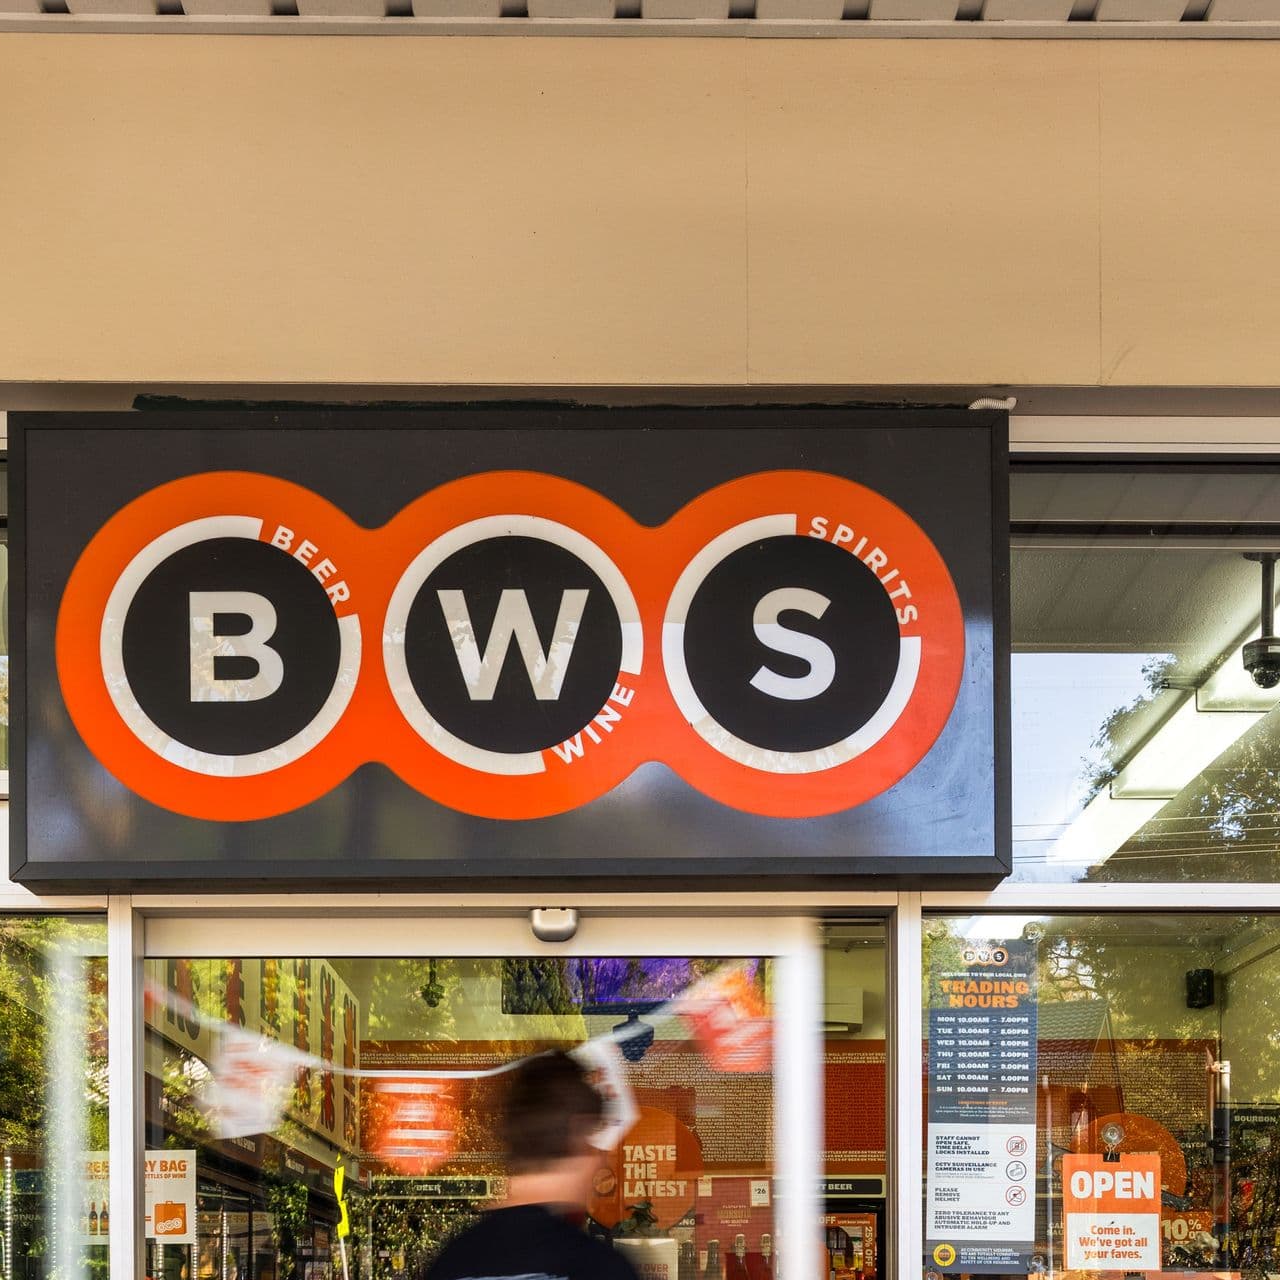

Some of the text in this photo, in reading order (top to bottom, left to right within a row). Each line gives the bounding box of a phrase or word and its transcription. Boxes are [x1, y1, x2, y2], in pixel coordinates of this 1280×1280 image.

[269, 524, 352, 607] BEER
[807, 516, 921, 627] SPIRITS
[551, 680, 636, 765] WINE
[940, 981, 1029, 993] TRADING
[949, 995, 1019, 1008] HOURS
[623, 1145, 677, 1161] TASTE
[160, 1160, 186, 1172] BAG
[623, 1163, 657, 1179] THE
[623, 1181, 687, 1197] LATEST
[828, 1183, 852, 1191] BEER
[1071, 1171, 1154, 1199] OPEN
[1091, 1225, 1136, 1235] Come in.
[865, 1227, 873, 1267] 25% OFF
[1079, 1237, 1147, 1250] We've got all
[1084, 1249, 1142, 1262] your faves.
